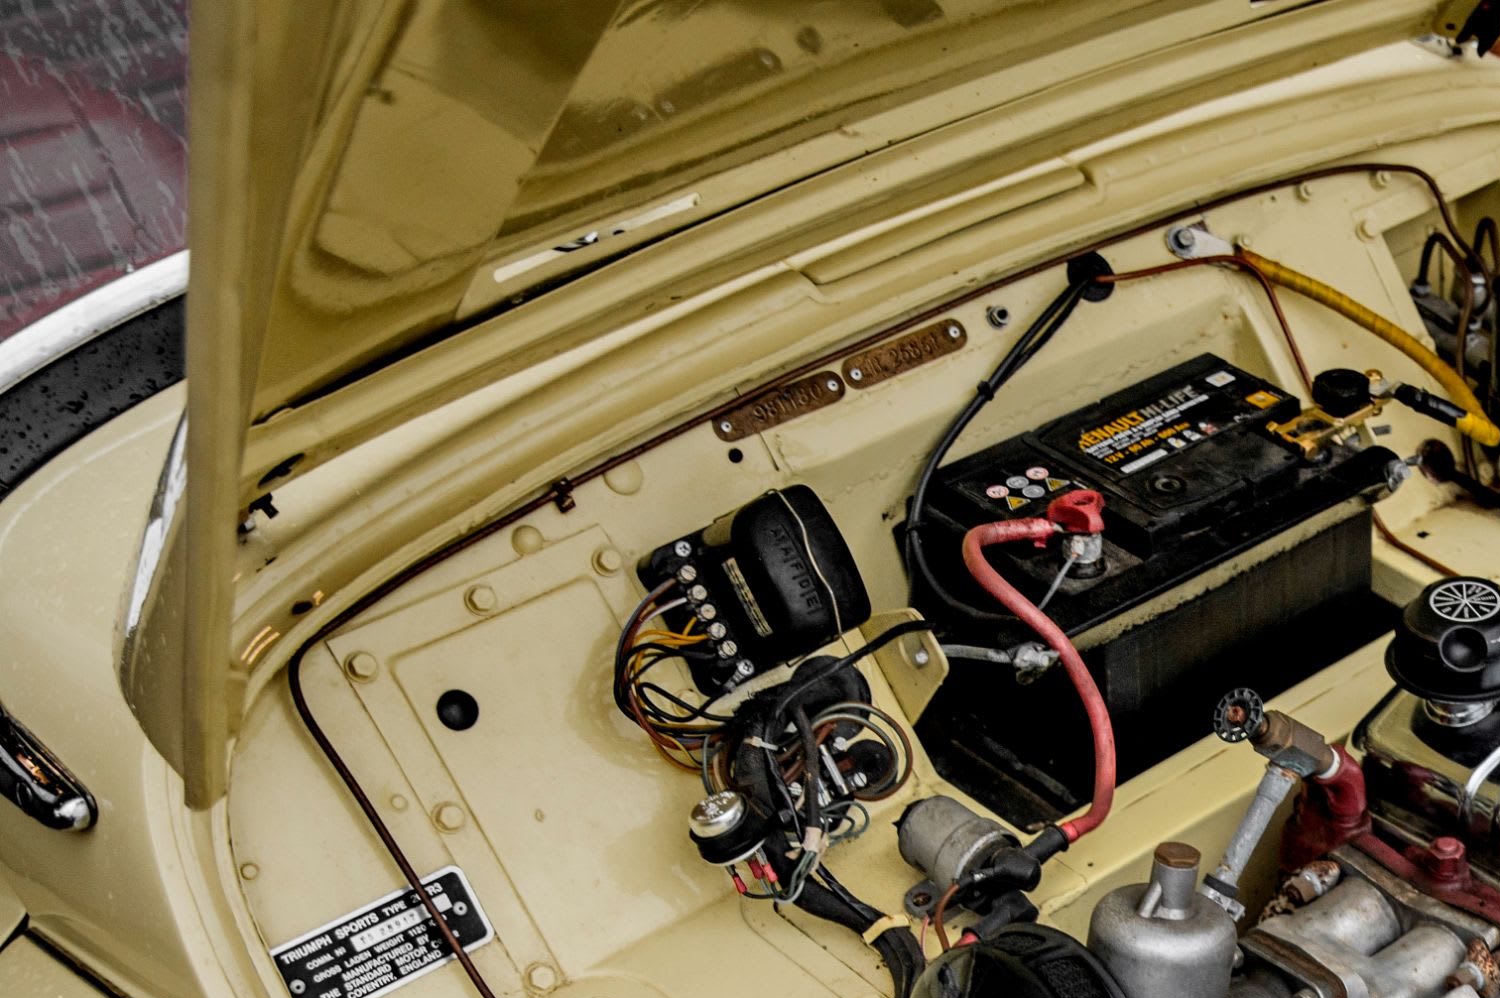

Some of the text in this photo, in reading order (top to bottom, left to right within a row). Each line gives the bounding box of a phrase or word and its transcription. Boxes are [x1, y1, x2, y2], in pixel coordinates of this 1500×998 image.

[280, 935, 332, 964] TRIUMPH
[335, 912, 379, 939] SPORTS
[382, 900, 407, 916] TYPE
[313, 965, 342, 983] GROSS
[344, 950, 372, 968] LADEN
[371, 931, 404, 953] WEIGHT
[342, 943, 413, 983] MANUFACTURED
[416, 934, 429, 945] BY
[344, 960, 391, 991] STANDARD
[392, 943, 428, 966] MOTOR
